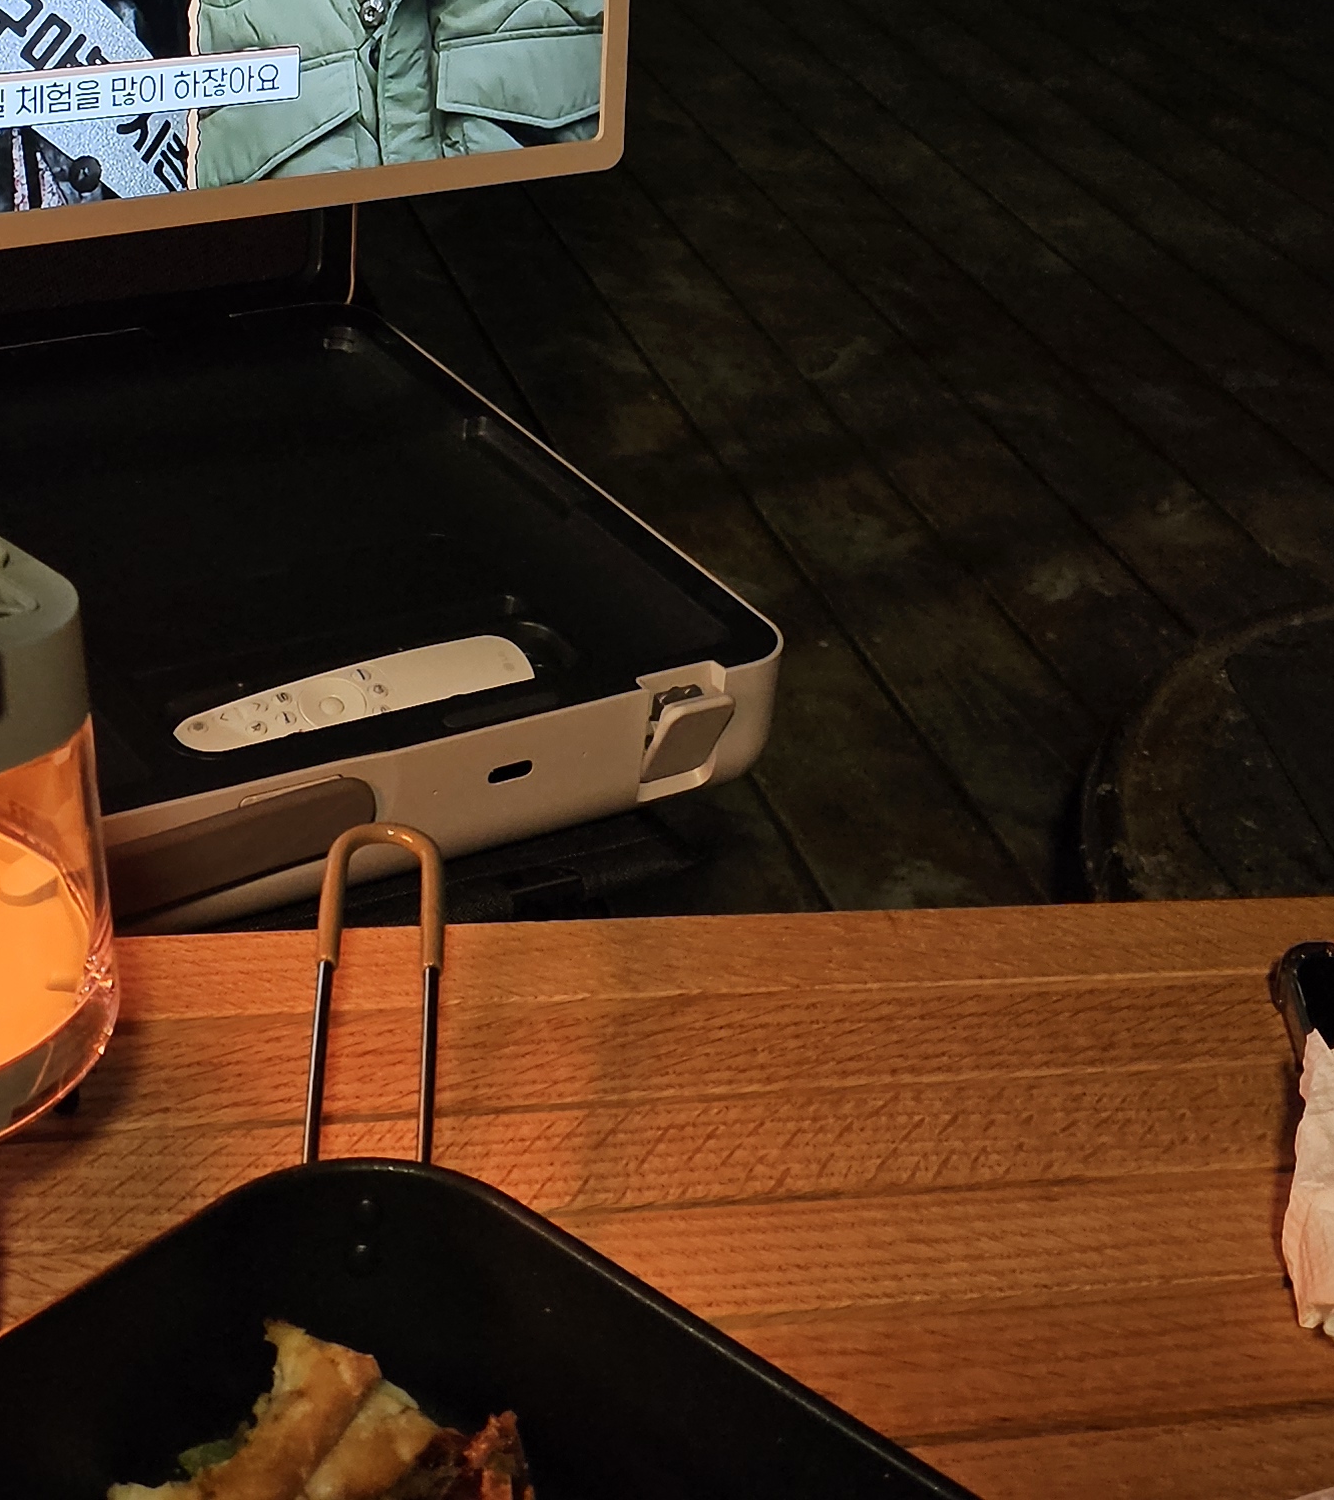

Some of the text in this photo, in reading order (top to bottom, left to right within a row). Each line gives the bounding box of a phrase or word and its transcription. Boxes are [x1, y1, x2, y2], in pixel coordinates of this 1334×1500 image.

[15, 79, 101, 116] 체험을
[110, 73, 165, 107] 많이
[173, 63, 281, 99] 하잖아요
